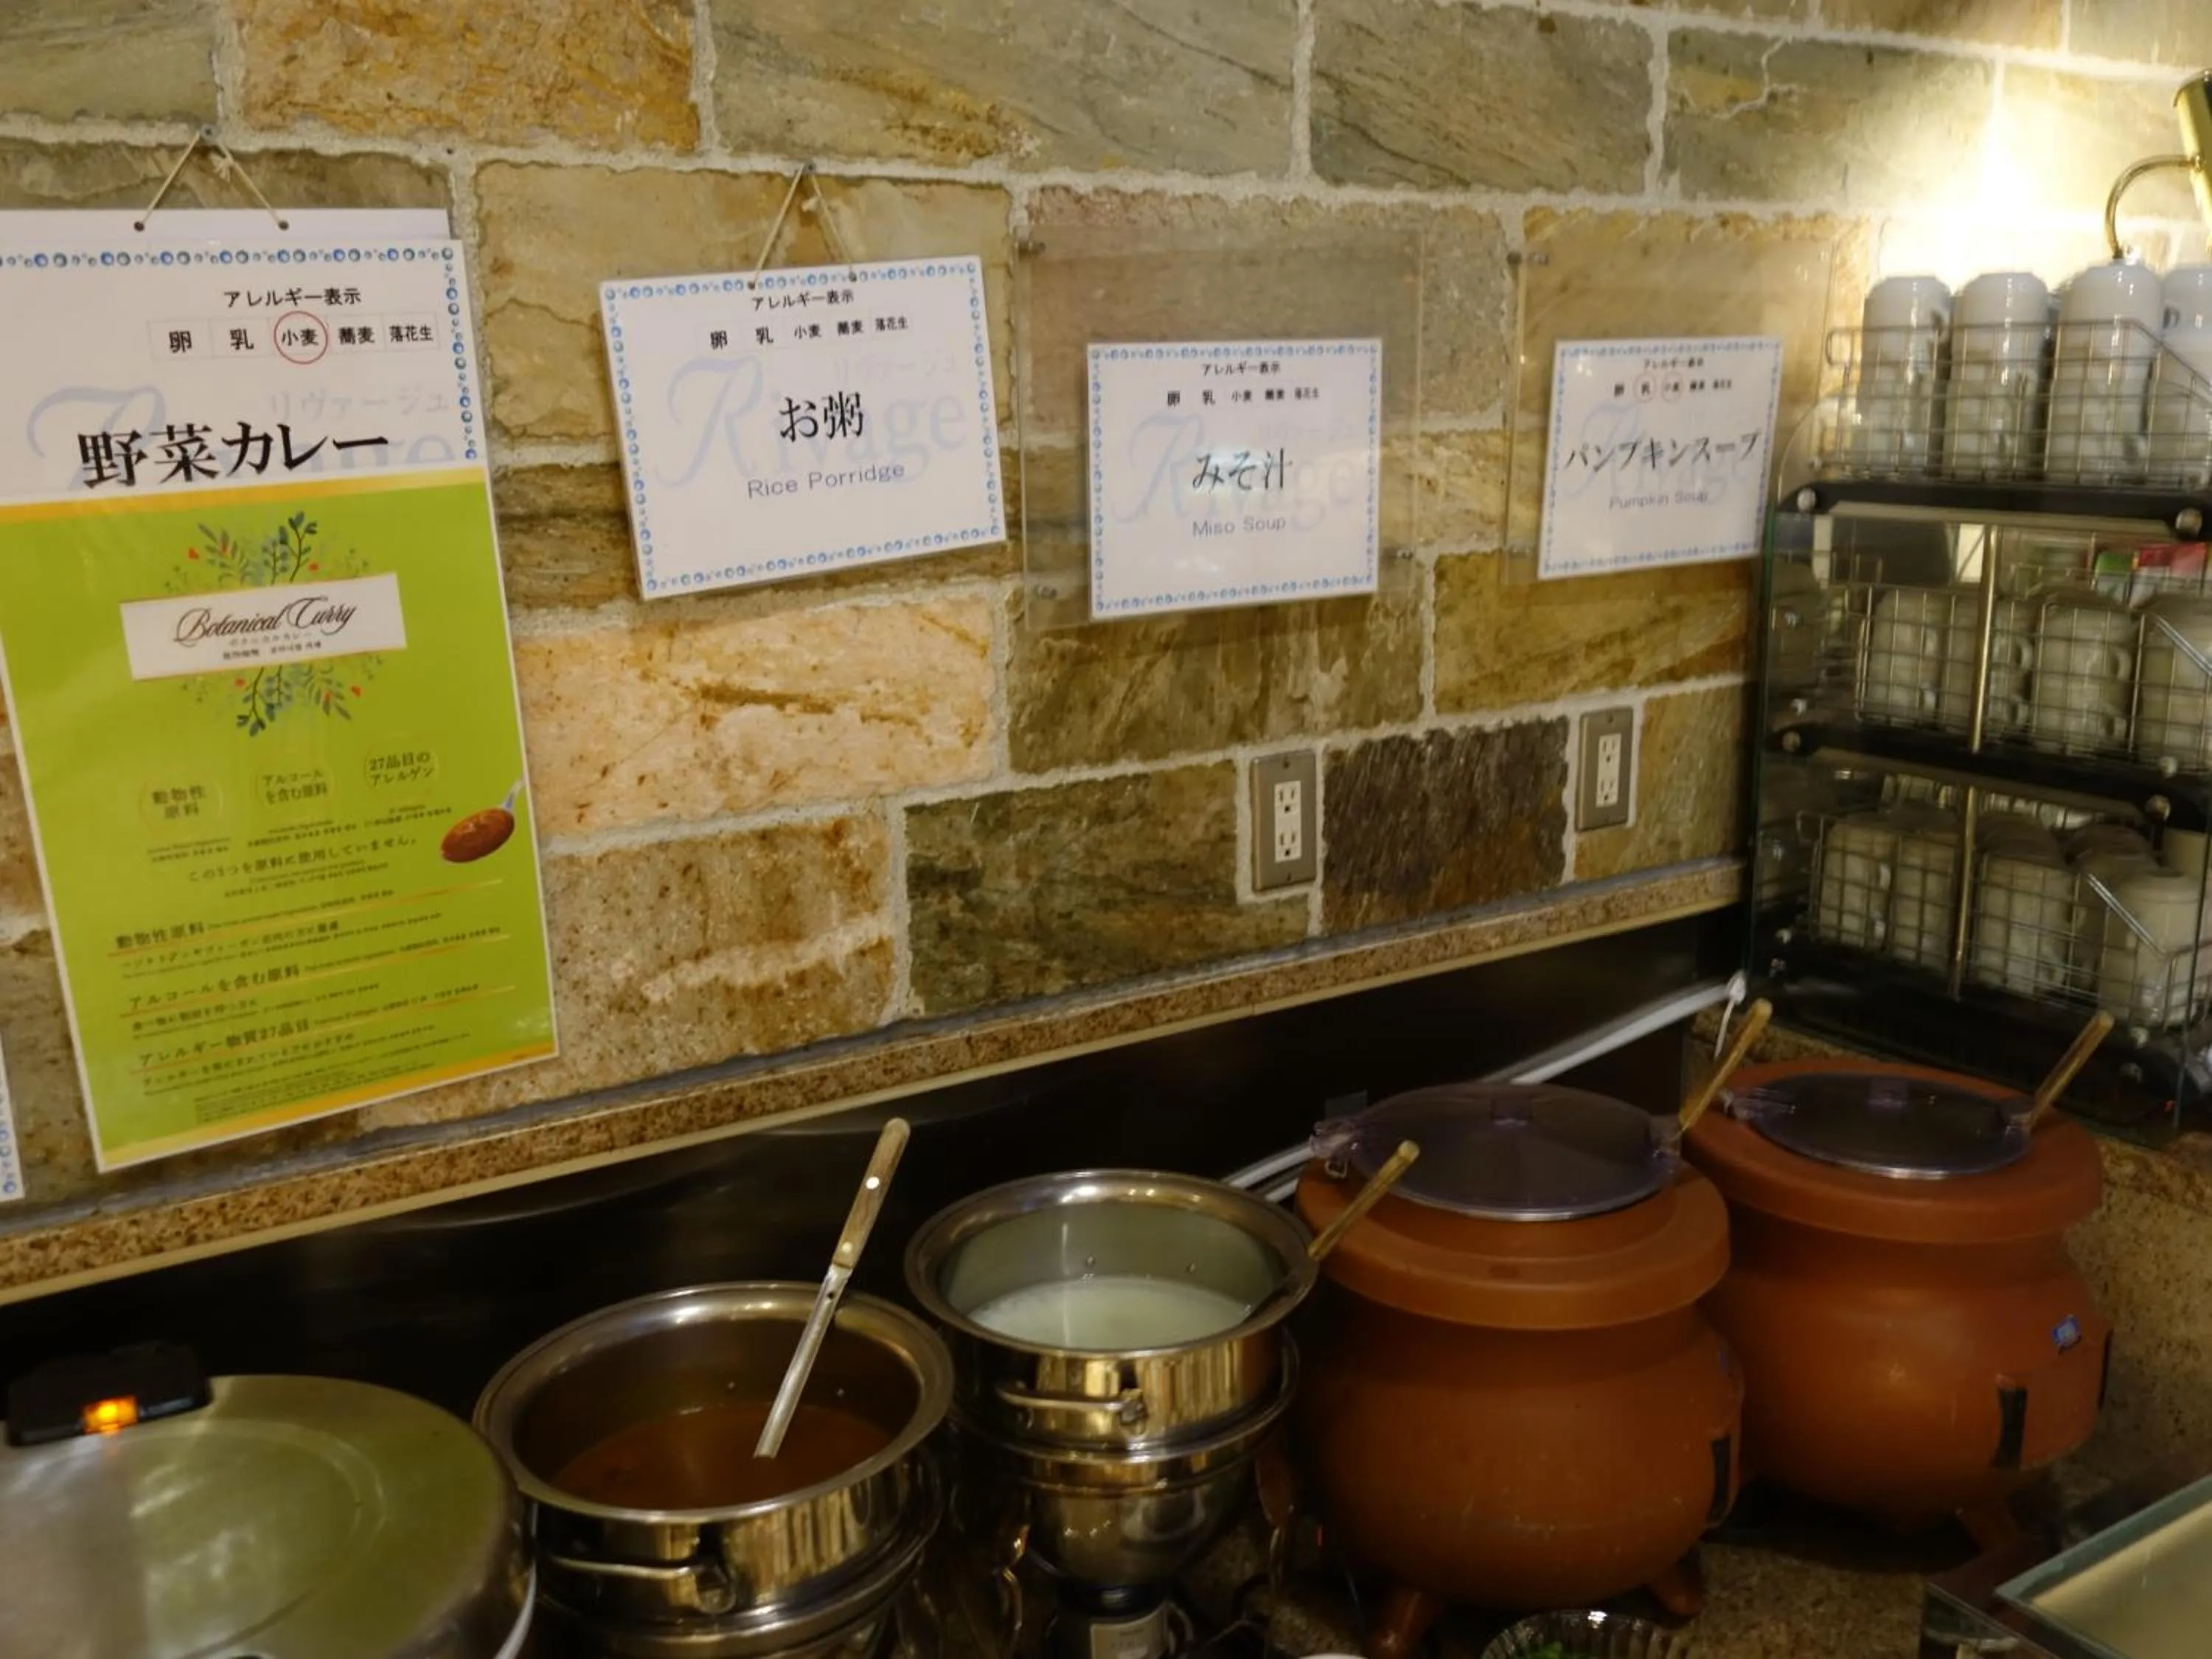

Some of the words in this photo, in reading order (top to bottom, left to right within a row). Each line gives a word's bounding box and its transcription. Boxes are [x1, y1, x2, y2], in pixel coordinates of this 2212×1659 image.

[223, 288, 361, 308] アレルギー表示
[752, 289, 855, 311] アレルギー表示
[168, 330, 192, 353] 卵
[229, 328, 254, 351] 乳
[281, 327, 319, 347] 小麦
[339, 325, 375, 345] 蕎麦
[389, 324, 434, 343] 落花生
[710, 330, 728, 349] 卵
[756, 327, 773, 345] 乳
[793, 324, 822, 340] 小麦
[875, 316, 908, 332] 落花生
[1203, 361, 1281, 376] アレルギー表示
[779, 391, 865, 443] お粥
[77, 421, 389, 490] 野菜カレー
[748, 473, 799, 499] Rice
[809, 464, 905, 490] Porridge
[1192, 448, 1293, 492] みそ汁
[1192, 519, 1235, 538] Miso
[1242, 515, 1287, 533] Soup
[174, 602, 292, 648] Botanical
[286, 596, 357, 636] Curry
[369, 752, 431, 772] 27品目の
[262, 769, 324, 787] アルコール
[371, 766, 434, 787] アレルゲン
[152, 785, 206, 804] 動物性
[266, 782, 328, 805] を含む原料
[164, 801, 200, 818] 原料
[116, 922, 204, 949] 動物性原料
[129, 964, 300, 1010] アルコールを含む原料
